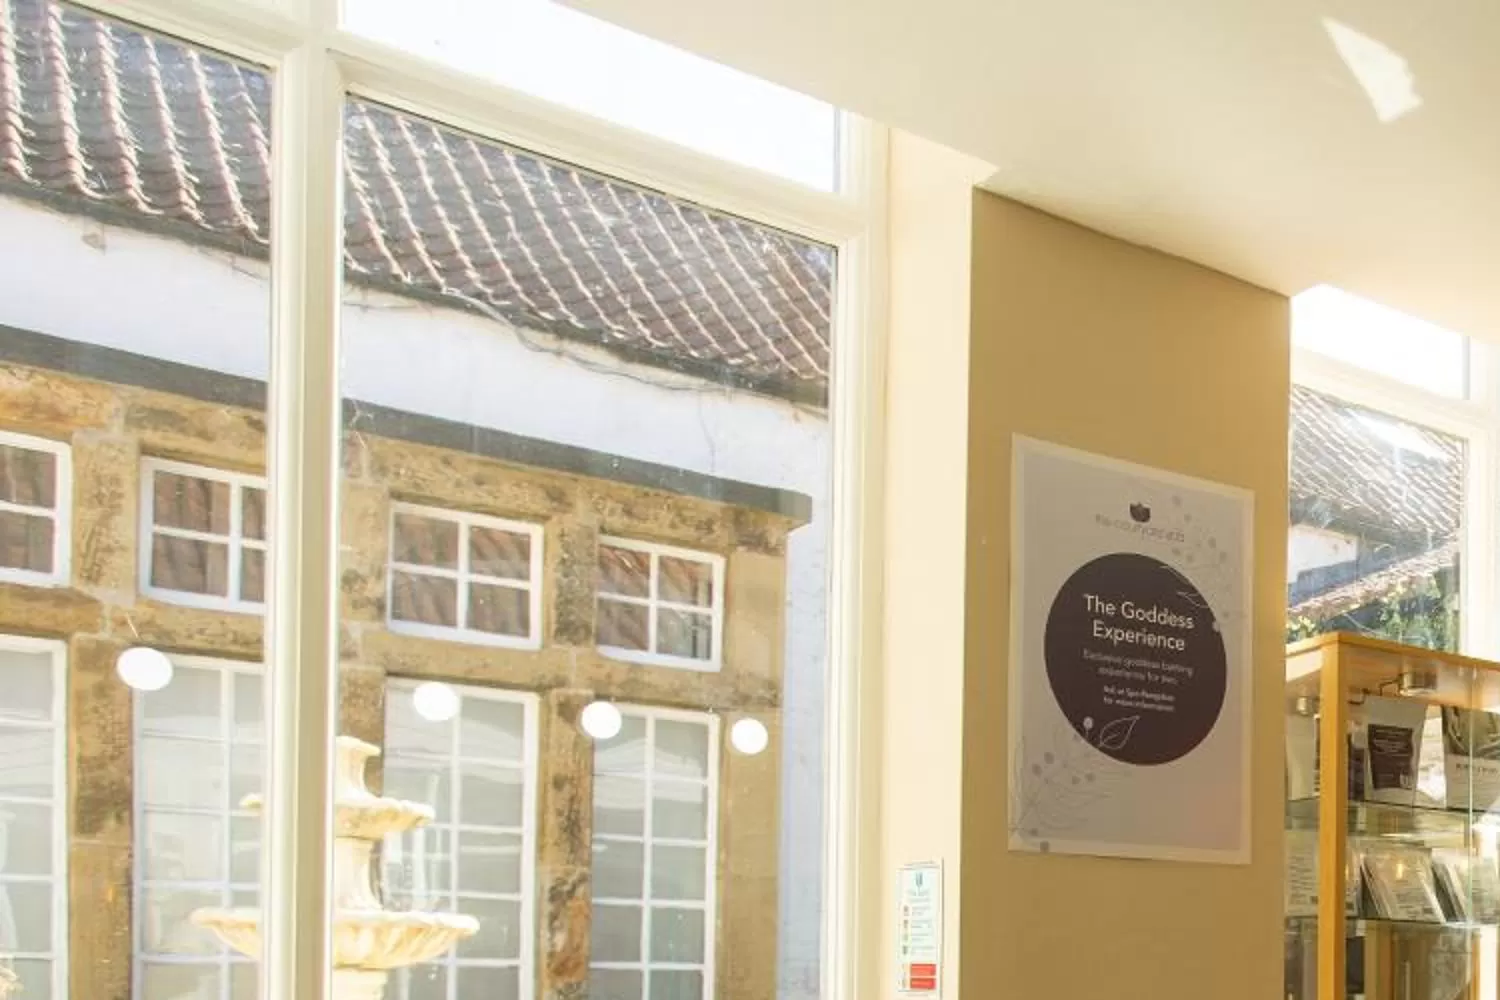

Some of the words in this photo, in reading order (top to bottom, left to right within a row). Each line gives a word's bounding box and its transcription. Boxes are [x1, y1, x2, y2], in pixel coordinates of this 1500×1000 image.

[1082, 593, 1116, 616] The
[1121, 601, 1195, 629] Goddess
[1093, 619, 1185, 651] Experience
